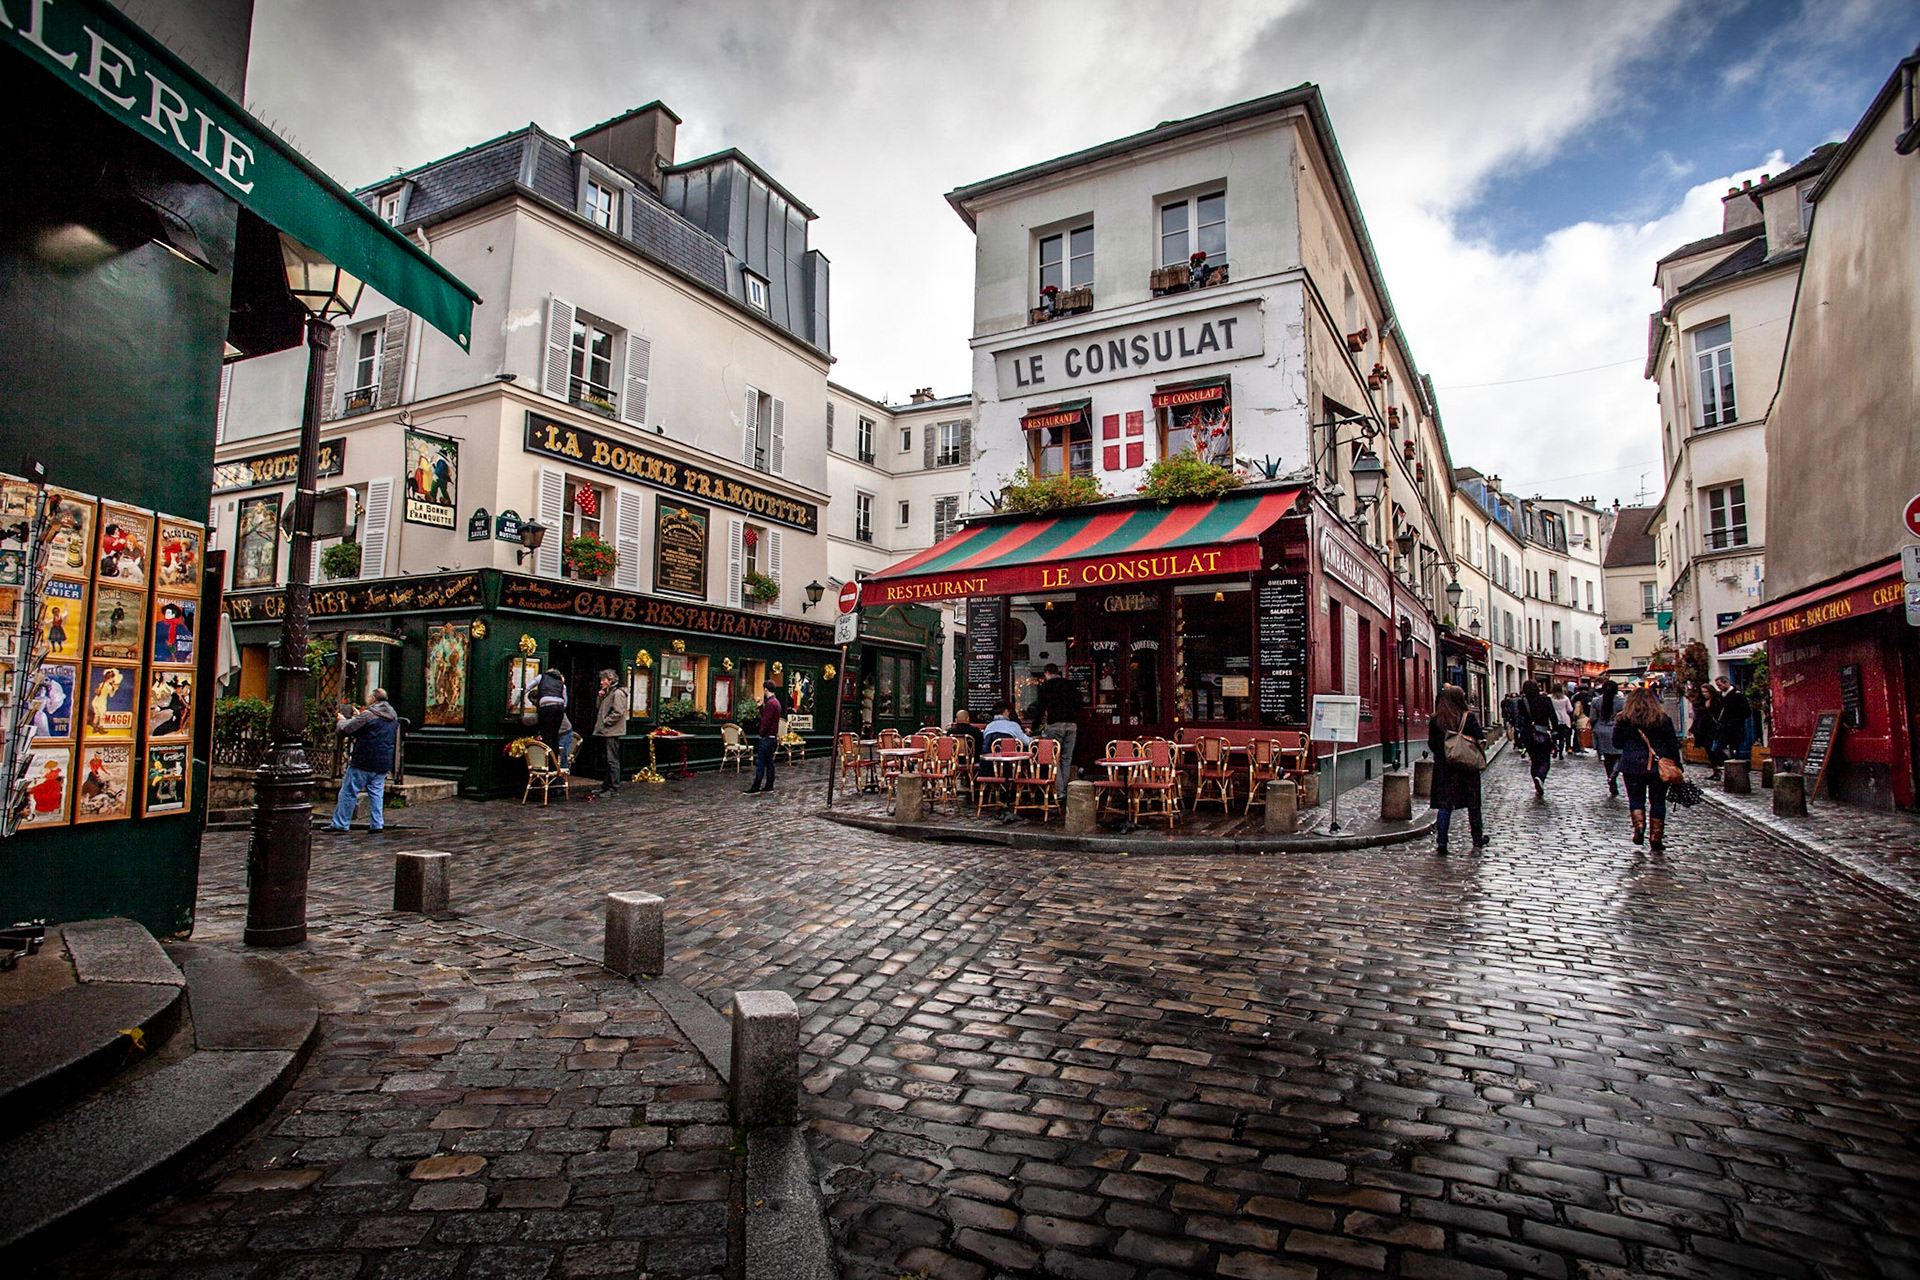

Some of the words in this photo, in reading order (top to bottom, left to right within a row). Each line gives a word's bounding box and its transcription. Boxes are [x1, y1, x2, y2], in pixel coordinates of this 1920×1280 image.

[0, 0, 255, 195] LERIE
[1014, 355, 1045, 388] LE
[1065, 317, 1238, 378] CONSULAT
[1157, 395, 1170, 407] LE
[1172, 388, 1216, 403] CONSULAT
[1026, 412, 1074, 429] RESTAURANT
[544, 424, 583, 459] LA
[592, 439, 677, 485] BONNE
[683, 468, 808, 525] FRANQUETTE
[408, 509, 452, 525] FRANQUETTE
[414, 502, 423, 511] LA
[425, 504, 449, 515] BONNE
[471, 530, 488, 538] SAULES
[886, 578, 988, 601] RESTAURANT
[1042, 568, 1070, 588] LE
[1081, 551, 1222, 583] CONSULAT
[1325, 540, 1364, 588] AMBASSADE
[645, 601, 773, 639] RESTAURANT
[778, 621, 811, 643] VINS
[840, 616, 851, 625] SAUF
[1744, 629, 1756, 643] BAR
[1768, 621, 1778, 636] LE
[1780, 614, 1801, 634] TIRE
[1806, 598, 1852, 626] BOUCHON
[104, 714, 131, 725] MAGGI
